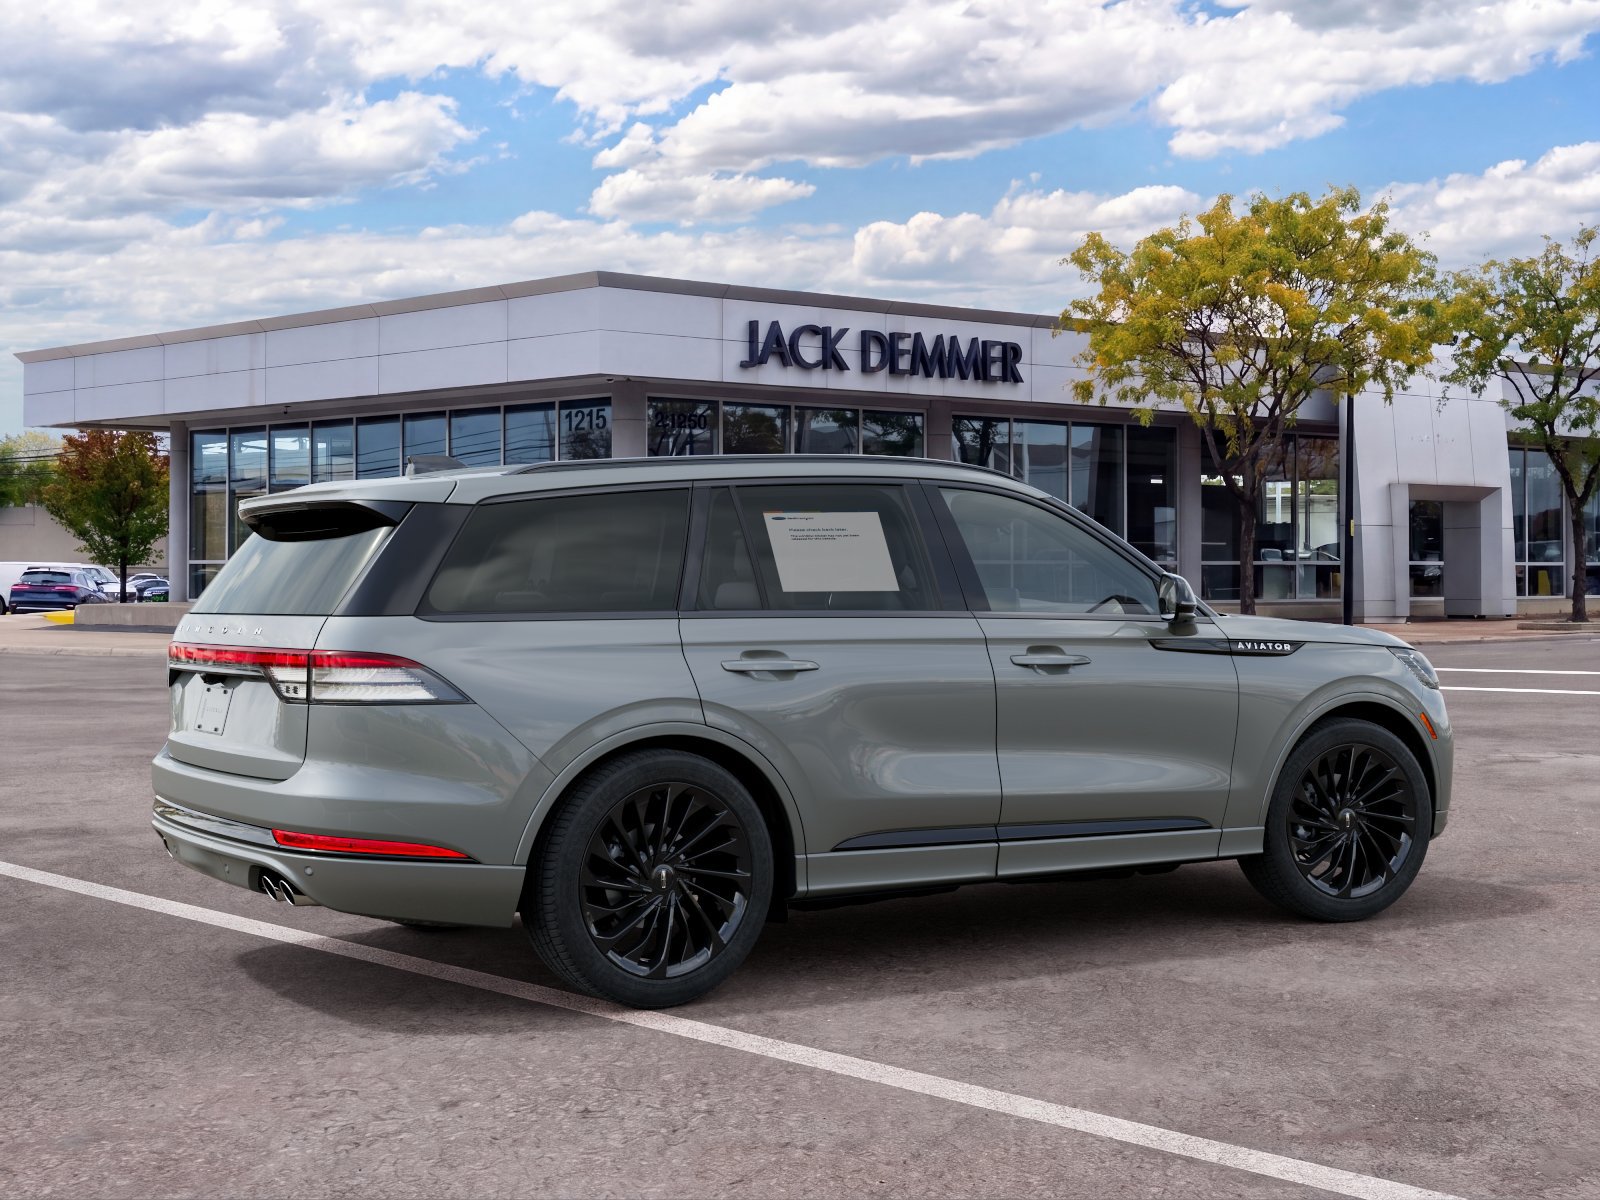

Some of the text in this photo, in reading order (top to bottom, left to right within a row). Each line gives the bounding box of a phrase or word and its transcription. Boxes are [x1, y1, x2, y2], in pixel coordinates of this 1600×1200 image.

[740, 320, 1024, 383] JACK DEMMER
[565, 408, 607, 431] 1215
[1238, 641, 1291, 651] AVIATOR
